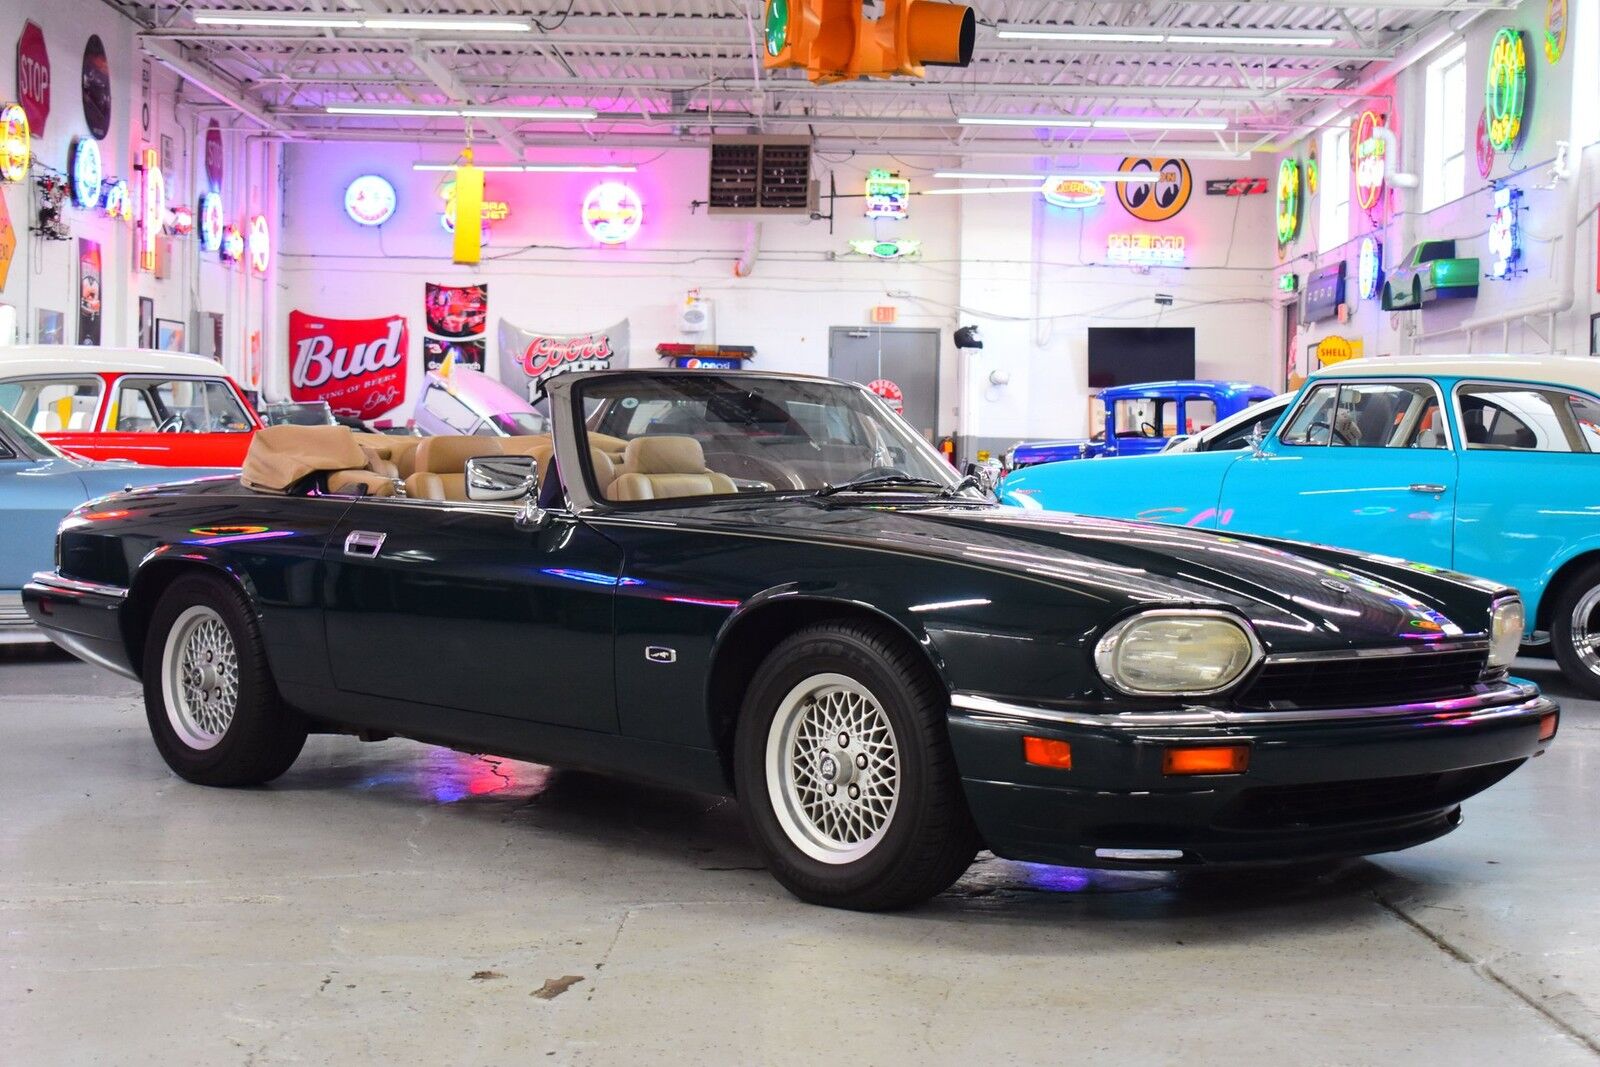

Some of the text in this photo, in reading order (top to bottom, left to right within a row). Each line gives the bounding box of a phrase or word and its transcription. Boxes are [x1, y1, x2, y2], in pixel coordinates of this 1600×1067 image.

[20, 53, 49, 104] STOP
[292, 320, 404, 389] Bud
[516, 334, 613, 377] Coors
[1321, 348, 1347, 357] SHELL
[319, 389, 345, 401] KING
[363, 373, 398, 389] BEERS
